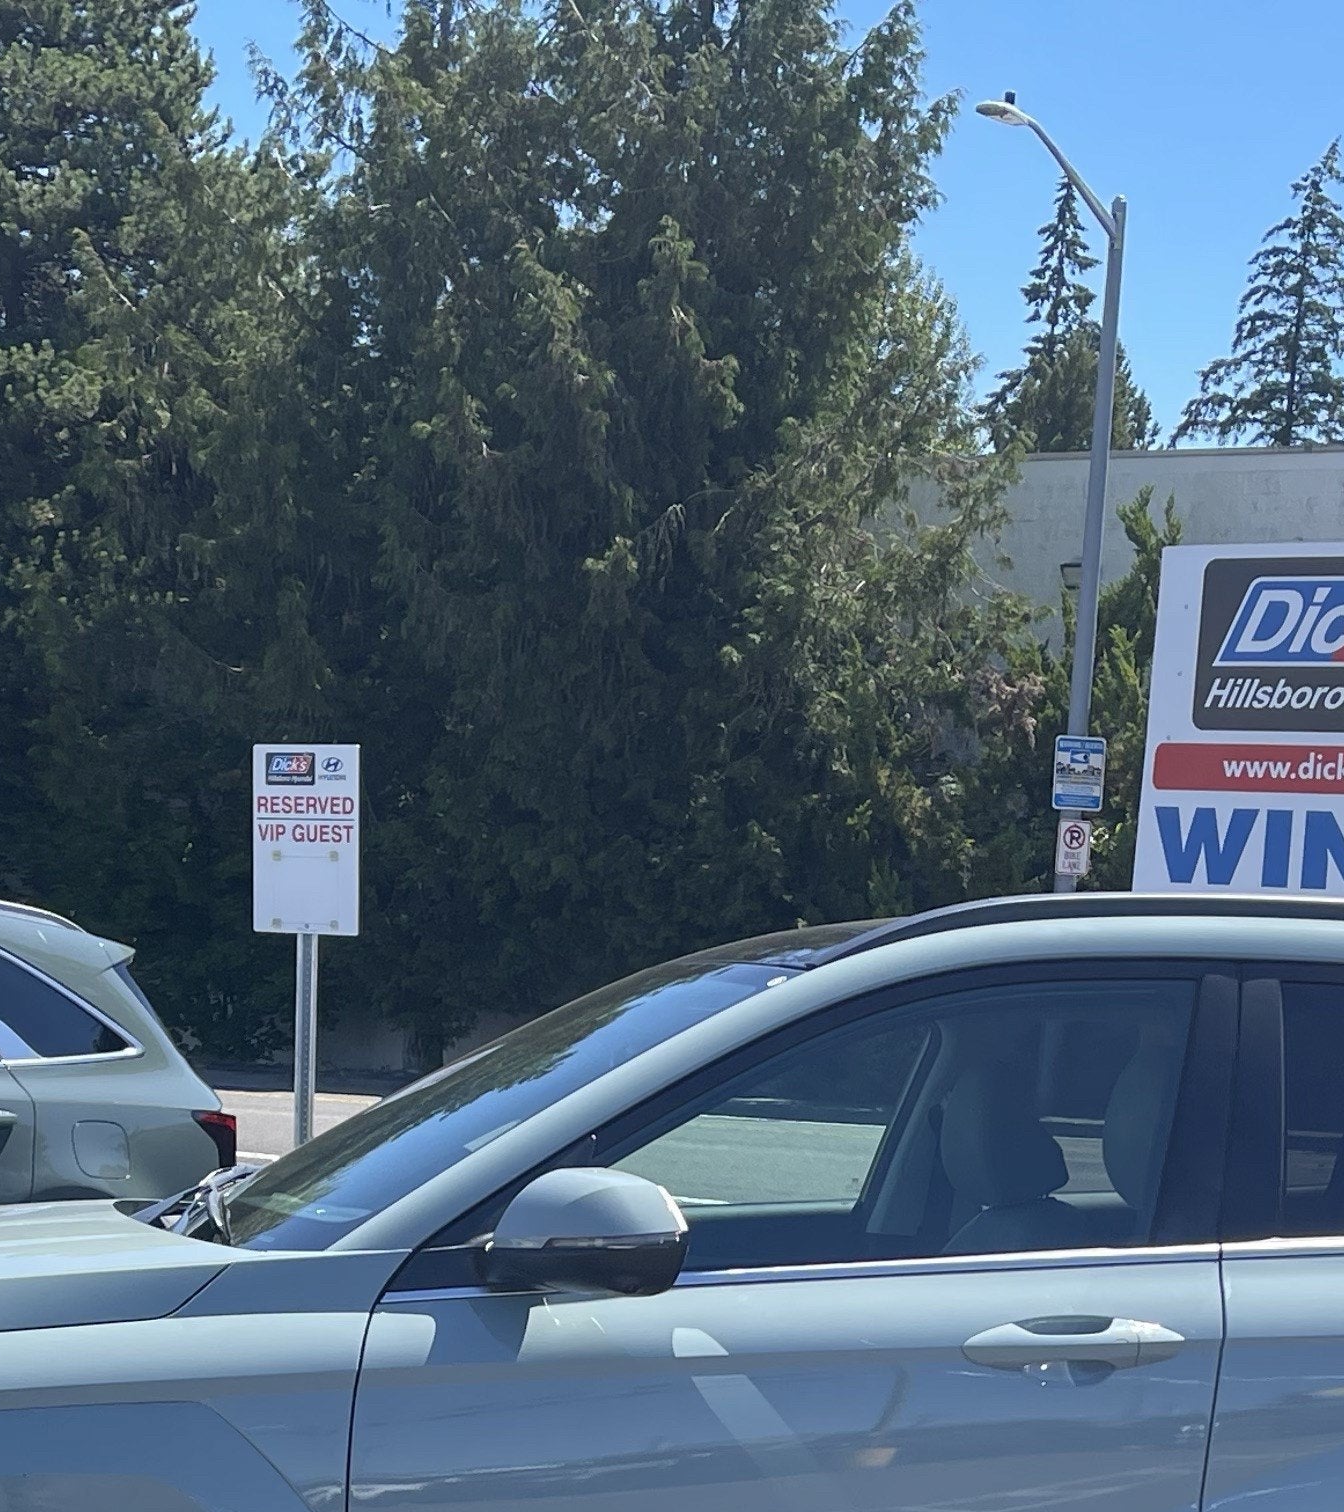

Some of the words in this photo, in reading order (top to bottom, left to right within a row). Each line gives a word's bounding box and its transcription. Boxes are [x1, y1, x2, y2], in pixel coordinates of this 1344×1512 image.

[257, 795, 355, 816] RESERVED
[258, 823, 286, 842] VIP
[291, 824, 354, 844] GUEST
